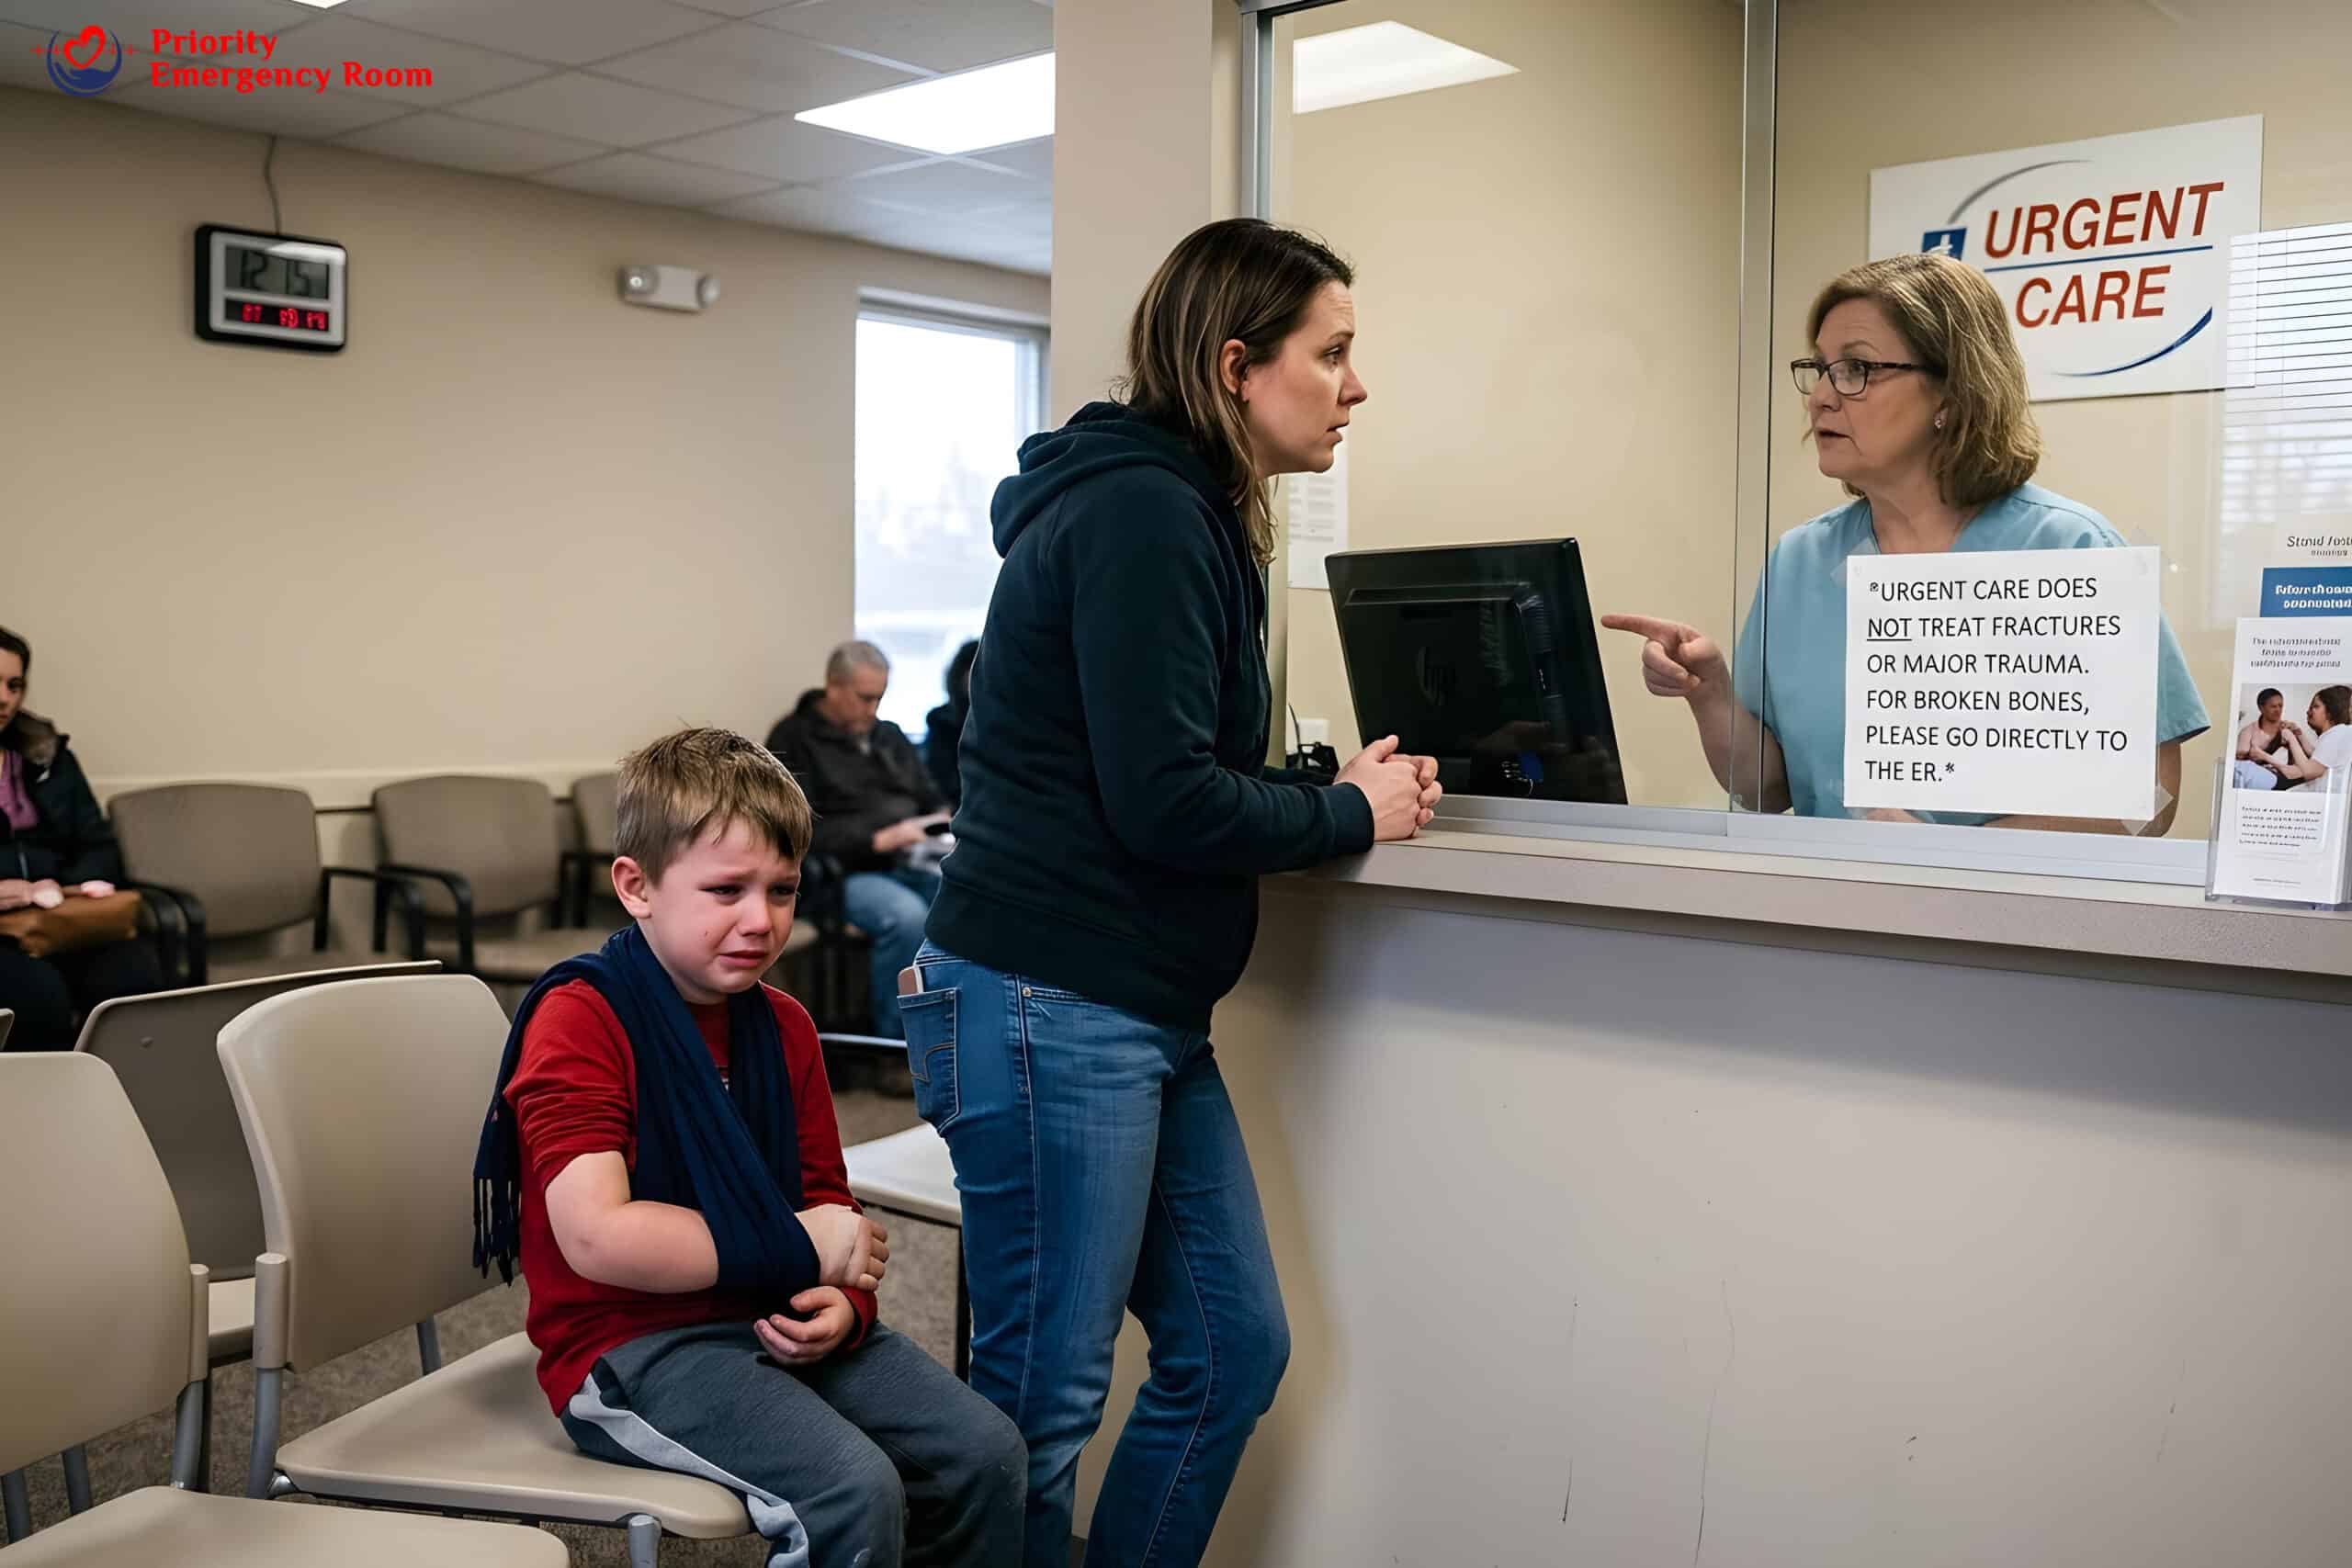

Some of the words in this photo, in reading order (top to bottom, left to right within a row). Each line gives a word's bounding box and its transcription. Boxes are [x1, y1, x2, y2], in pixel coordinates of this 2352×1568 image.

[1984, 181, 2224, 258] URGENT
[2015, 265, 2171, 329] CARE
[1973, 580, 2030, 601] CARE
[2038, 578, 2098, 599] DOES
[1867, 617, 1912, 638] NOT
[1917, 616, 1985, 637] TREAT
[1992, 615, 2121, 637] FRACTURES
[1867, 653, 1896, 673] OR
[1904, 653, 1977, 674] MAJOR
[1984, 653, 2089, 674] TRAUMA.
[1867, 689, 1907, 709] FOR
[1914, 690, 2000, 711] BROKEN
[2008, 691, 2089, 716] BONES,
[1866, 725, 1939, 746] PLEASE
[1946, 727, 1978, 748] GO
[1985, 728, 2089, 750] DIRECTLY
[2096, 730, 2128, 751] TO
[1864, 760, 1905, 781] THE
